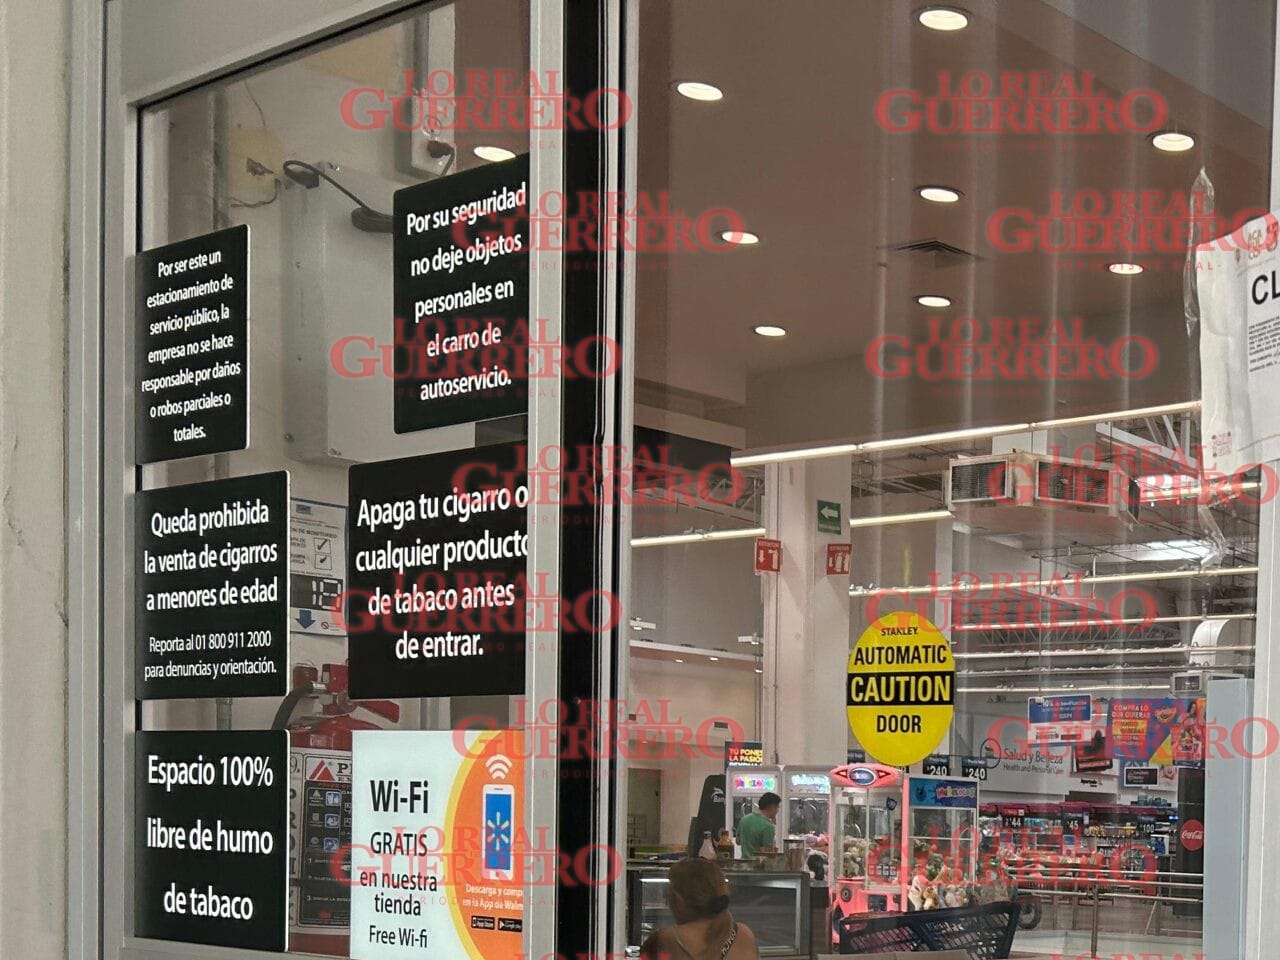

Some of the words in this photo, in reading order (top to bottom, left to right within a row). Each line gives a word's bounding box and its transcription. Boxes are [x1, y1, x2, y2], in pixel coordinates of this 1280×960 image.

[407, 213, 431, 235] Por
[433, 211, 449, 228] su
[452, 181, 526, 225] seguridad
[158, 261, 173, 278] Por
[174, 259, 187, 274] ser
[188, 254, 207, 270] este
[209, 250, 221, 265] un
[411, 256, 430, 276] no
[432, 247, 463, 273] deje
[466, 234, 522, 265] objetos
[147, 280, 219, 308] estacionamiento
[221, 274, 233, 291] de
[415, 282, 492, 323] personales
[495, 280, 514, 300] en
[149, 317, 183, 336] servicio
[184, 309, 219, 332] público,
[221, 303, 229, 320] la
[148, 344, 185, 364] empresa
[187, 342, 199, 355] no
[200, 339, 210, 352] se
[212, 333, 233, 349] hace
[427, 333, 439, 357] el
[442, 331, 479, 354] carro
[481, 322, 501, 345] de
[142, 367, 194, 393] responsable
[195, 368, 211, 385] por
[212, 361, 240, 381] daños
[420, 365, 512, 401] autoservicio.
[150, 405, 156, 418] o
[157, 399, 182, 416] robos
[184, 392, 223, 417] parciales
[224, 392, 231, 405] o
[174, 424, 206, 442] totales.
[151, 508, 196, 537] Queda
[199, 498, 269, 536] prohibida
[357, 499, 415, 533] Apaga
[419, 494, 439, 519] tu
[443, 487, 511, 523] cigarro
[515, 485, 528, 508] o
[144, 550, 156, 574] la
[159, 549, 196, 572] venta
[199, 544, 216, 568] de
[219, 542, 277, 572] cigarros
[356, 538, 440, 574] cualquier
[146, 594, 155, 610] a
[157, 588, 216, 609] menores
[219, 580, 238, 605] de
[240, 576, 278, 603] edad
[368, 587, 390, 615] de
[394, 584, 456, 614] tabaco
[461, 581, 515, 609] antes
[149, 636, 184, 655] Reporta
[186, 634, 194, 650] al
[196, 635, 206, 650] 01
[208, 633, 226, 649] 800
[228, 632, 244, 648] 911
[248, 630, 271, 647] 2000
[395, 630, 419, 659] de
[422, 631, 484, 657] entrar.
[854, 645, 947, 665] AUTOMATIC
[144, 665, 164, 681] para
[165, 660, 212, 677] denuncias
[212, 664, 219, 679] y
[221, 656, 277, 674] orientación.
[851, 676, 950, 702] CAUTION
[877, 715, 921, 733] DOOR
[148, 755, 216, 792] Espacio
[220, 756, 273, 786] 100%
[370, 780, 429, 813] Wi-Fi
[147, 817, 186, 849] libre
[189, 819, 213, 851] de
[217, 820, 273, 854] humo
[370, 832, 427, 856] GRATIS
[360, 870, 377, 887] en
[382, 871, 437, 892] nuestra
[465, 883, 496, 896] Descarga
[164, 882, 186, 914] de
[190, 885, 253, 920] tabaco
[375, 892, 421, 915] tienda
[370, 925, 395, 944] Free
[399, 928, 427, 948] Wi-fi
